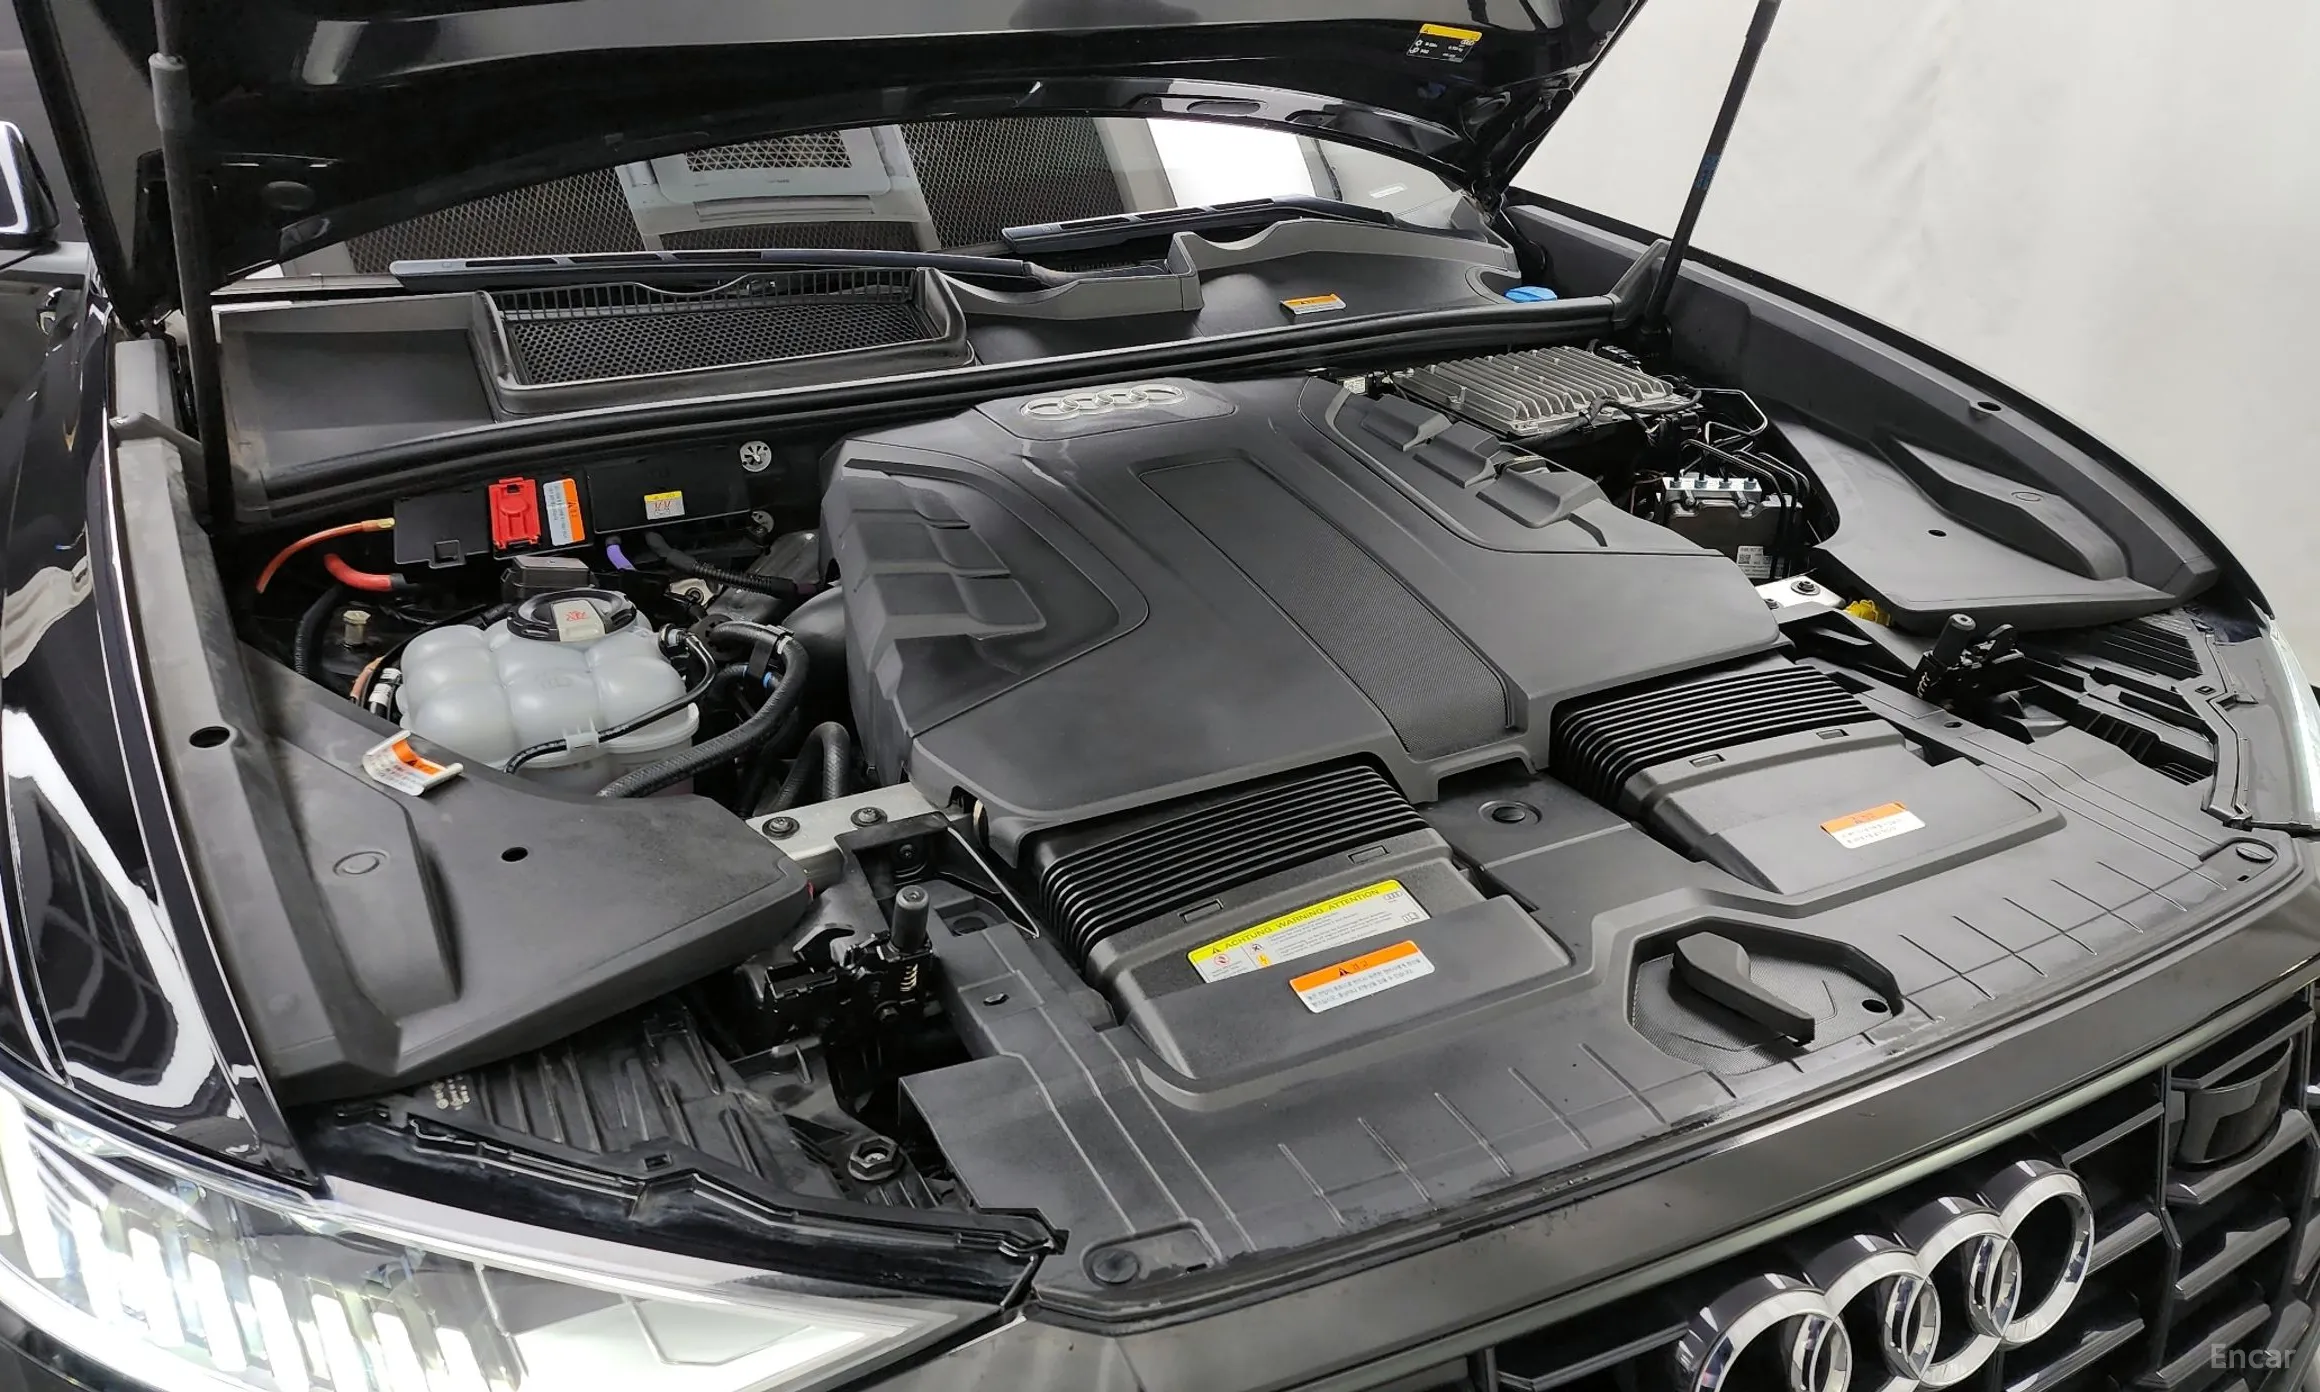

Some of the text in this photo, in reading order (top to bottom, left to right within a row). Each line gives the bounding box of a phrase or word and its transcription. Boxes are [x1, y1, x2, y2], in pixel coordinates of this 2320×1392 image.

[1224, 925, 1273, 950] ACHTUNG
[1275, 907, 1325, 930] WARNING
[1328, 888, 1381, 911] ATTENTION
